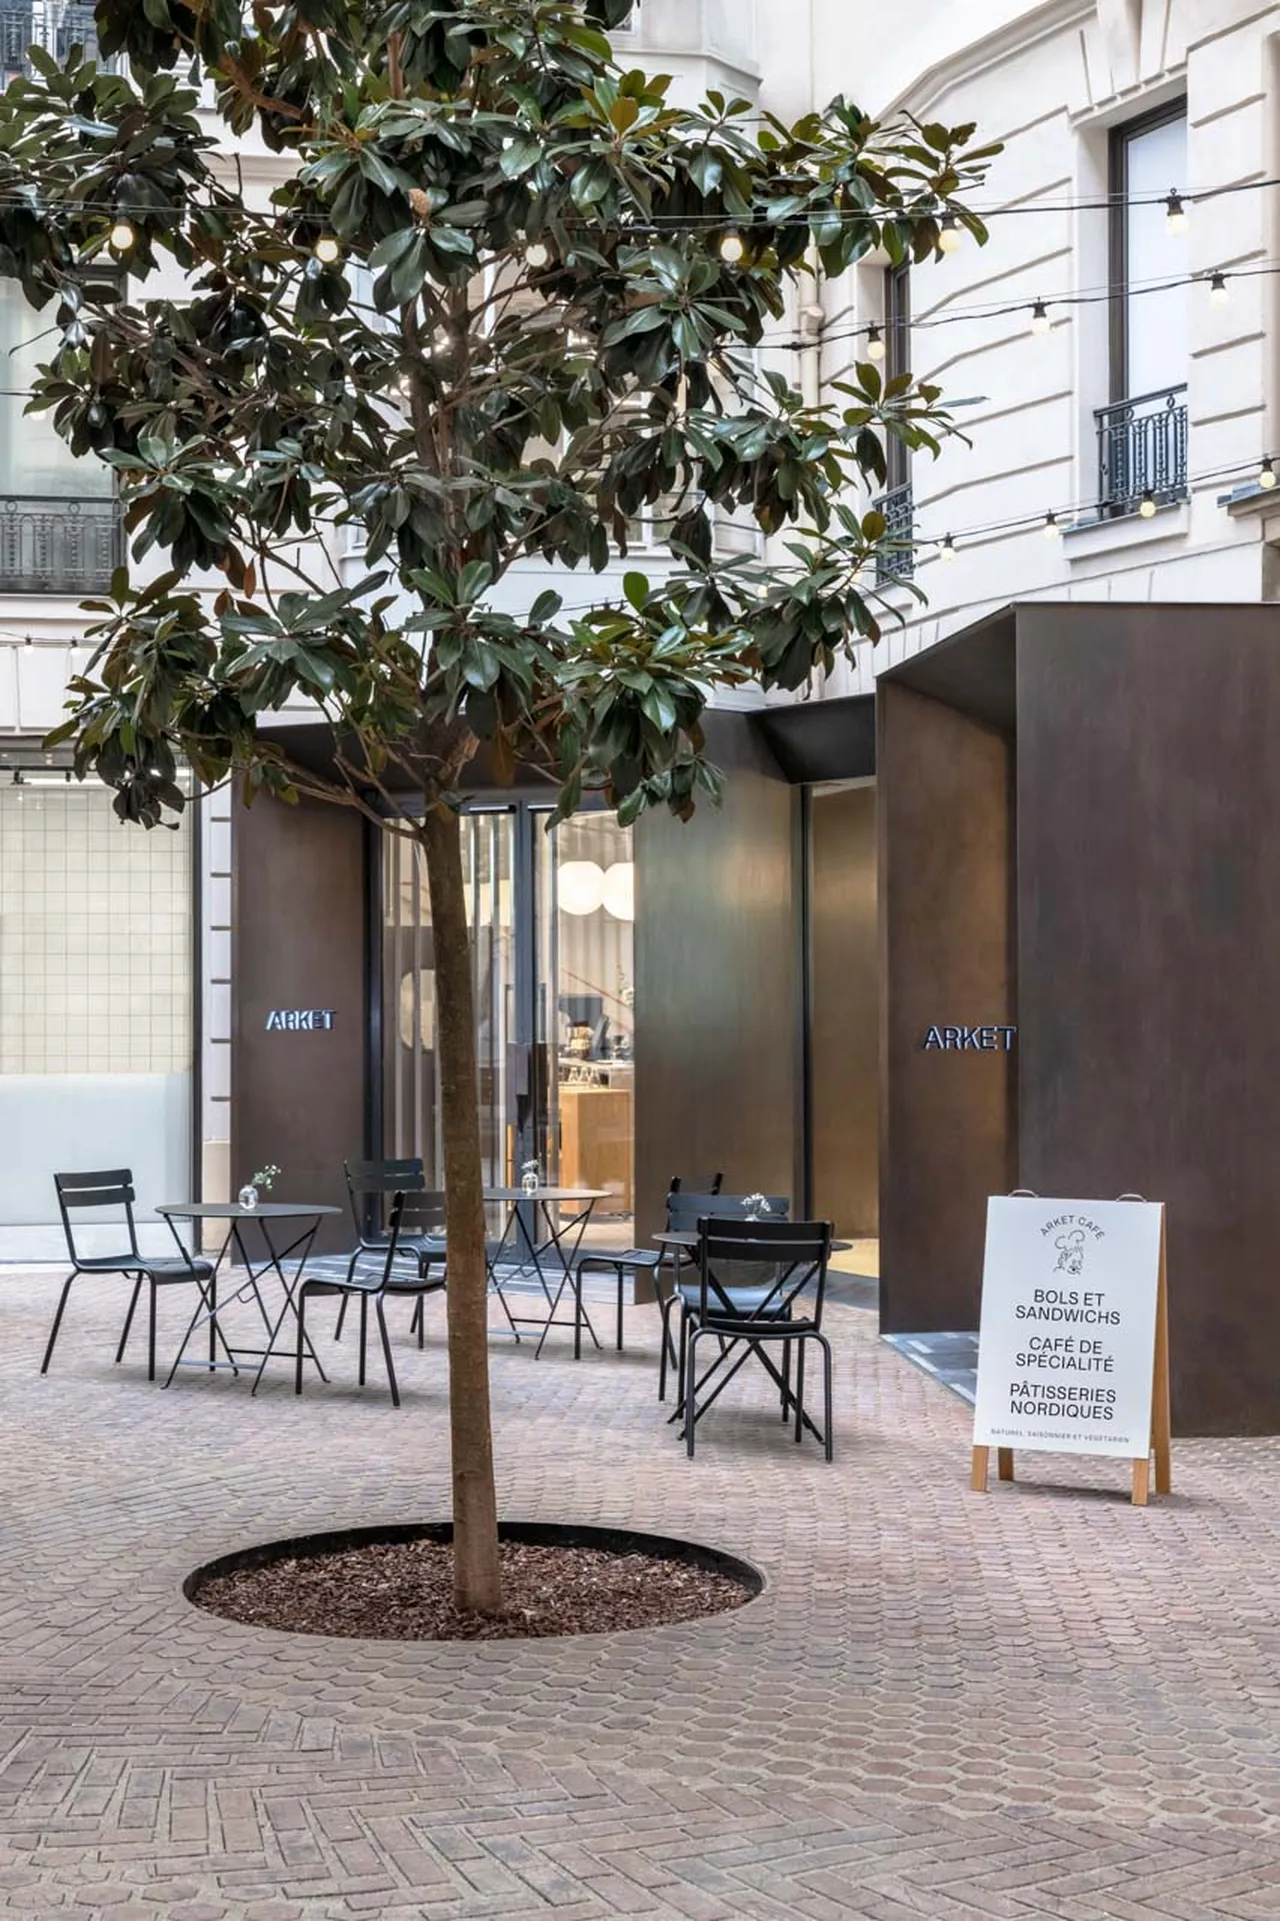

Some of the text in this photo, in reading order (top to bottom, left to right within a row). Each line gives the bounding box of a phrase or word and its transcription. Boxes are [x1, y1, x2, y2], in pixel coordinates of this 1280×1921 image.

[265, 1009, 337, 1030] ARKET
[923, 1026, 1017, 1050] ARKET
[1040, 1215, 1074, 1236] ARKET
[1034, 1289, 1105, 1306] BOLS ET
[1015, 1305, 1121, 1325] SANDWICHS
[1029, 1335, 1103, 1354] CAFÉ DE
[1015, 1351, 1114, 1372] SPÉCIALITÉ
[1010, 1380, 1116, 1403] PÂTISSERIES
[1010, 1400, 1114, 1420] NORDIQUES
